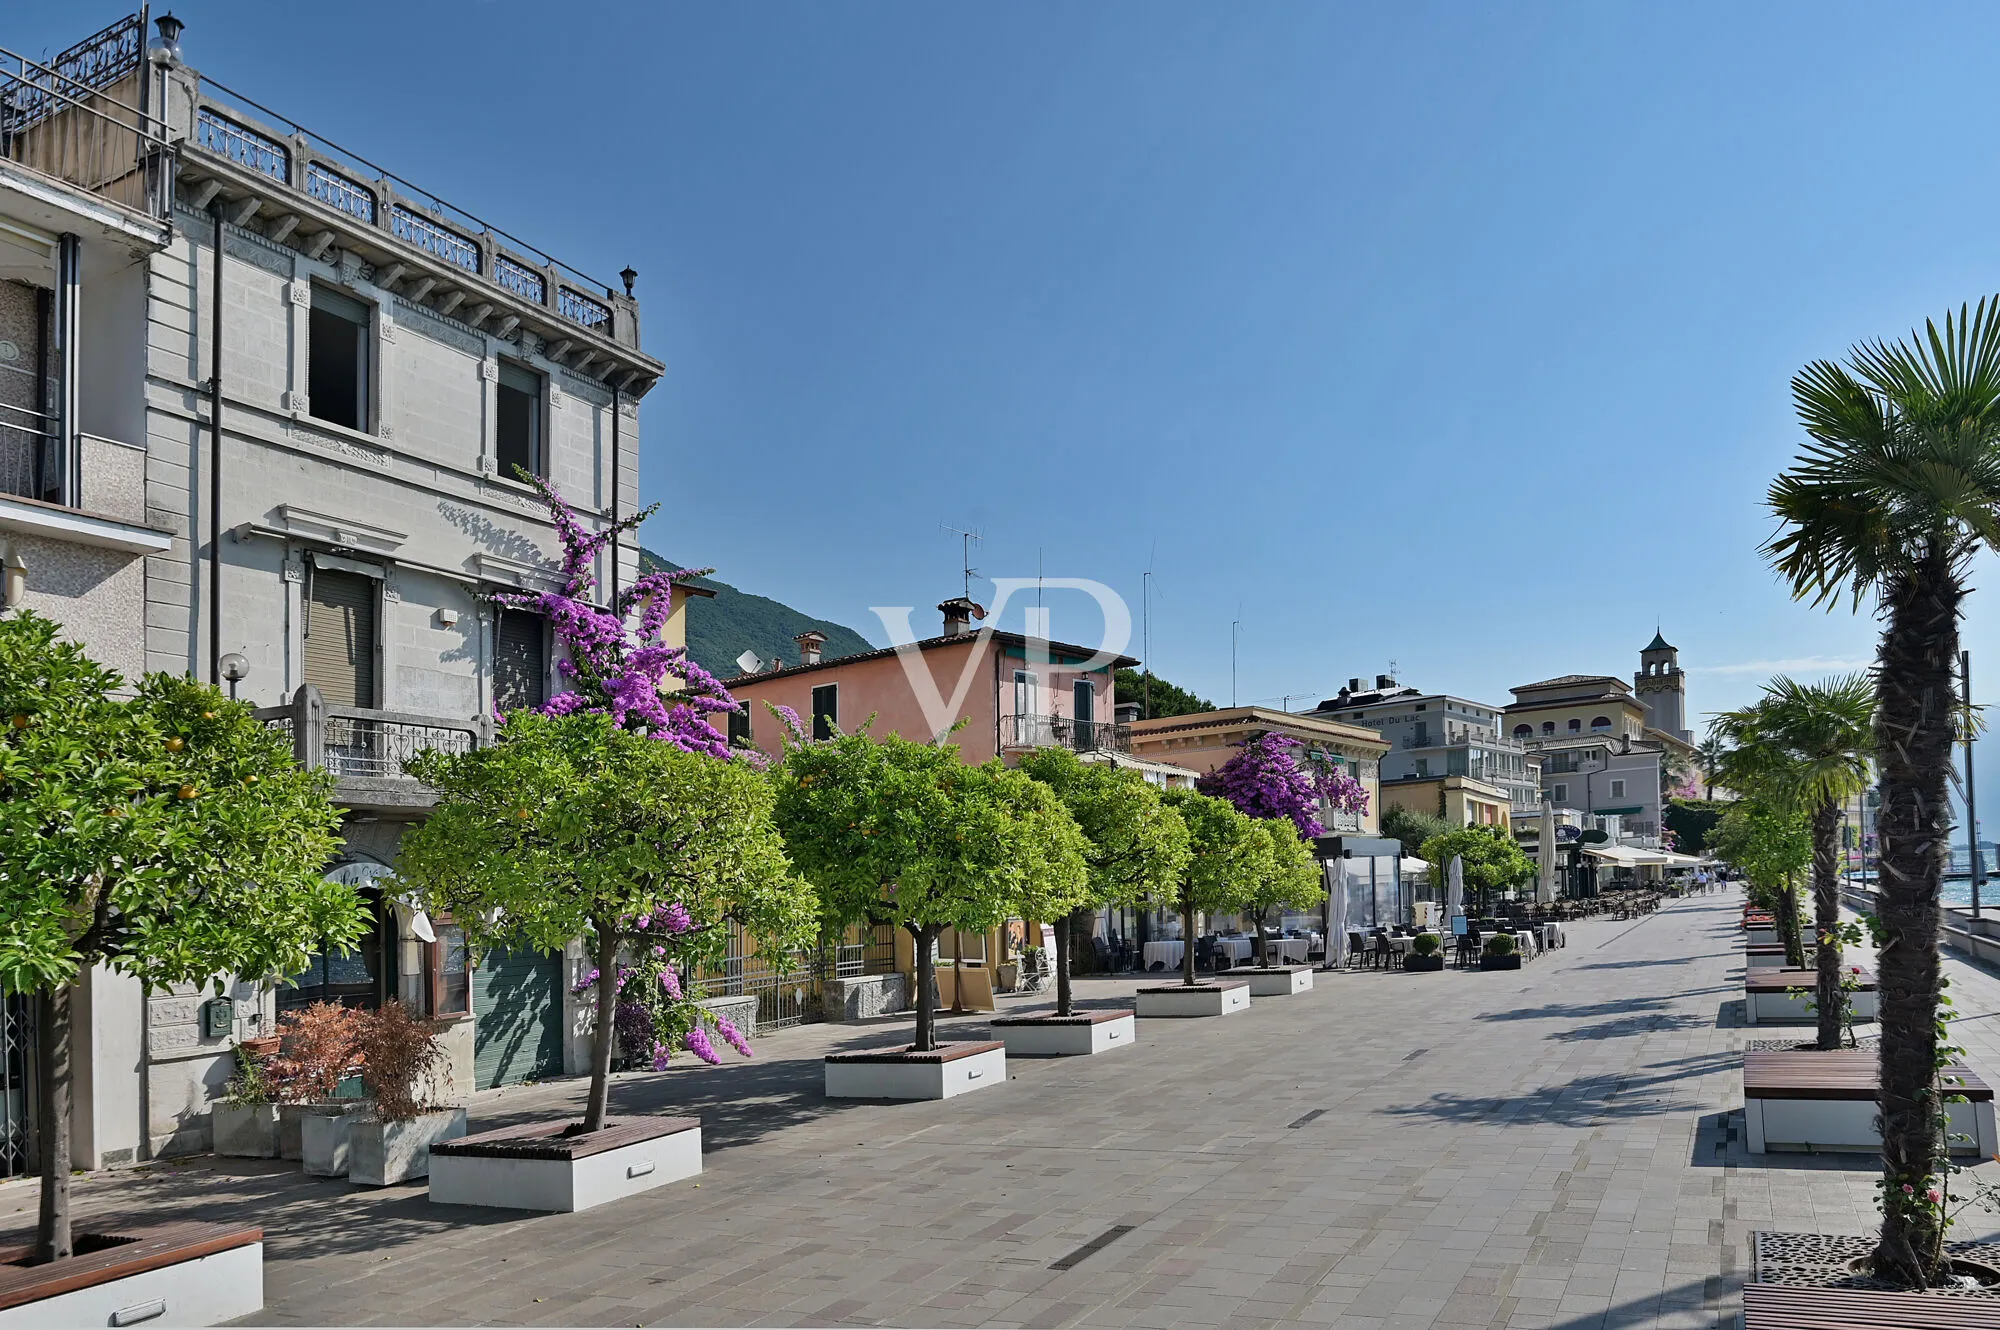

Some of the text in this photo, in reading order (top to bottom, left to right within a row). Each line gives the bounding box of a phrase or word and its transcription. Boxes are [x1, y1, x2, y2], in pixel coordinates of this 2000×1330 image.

[1361, 714, 1421, 728] Hotel Du Lac
